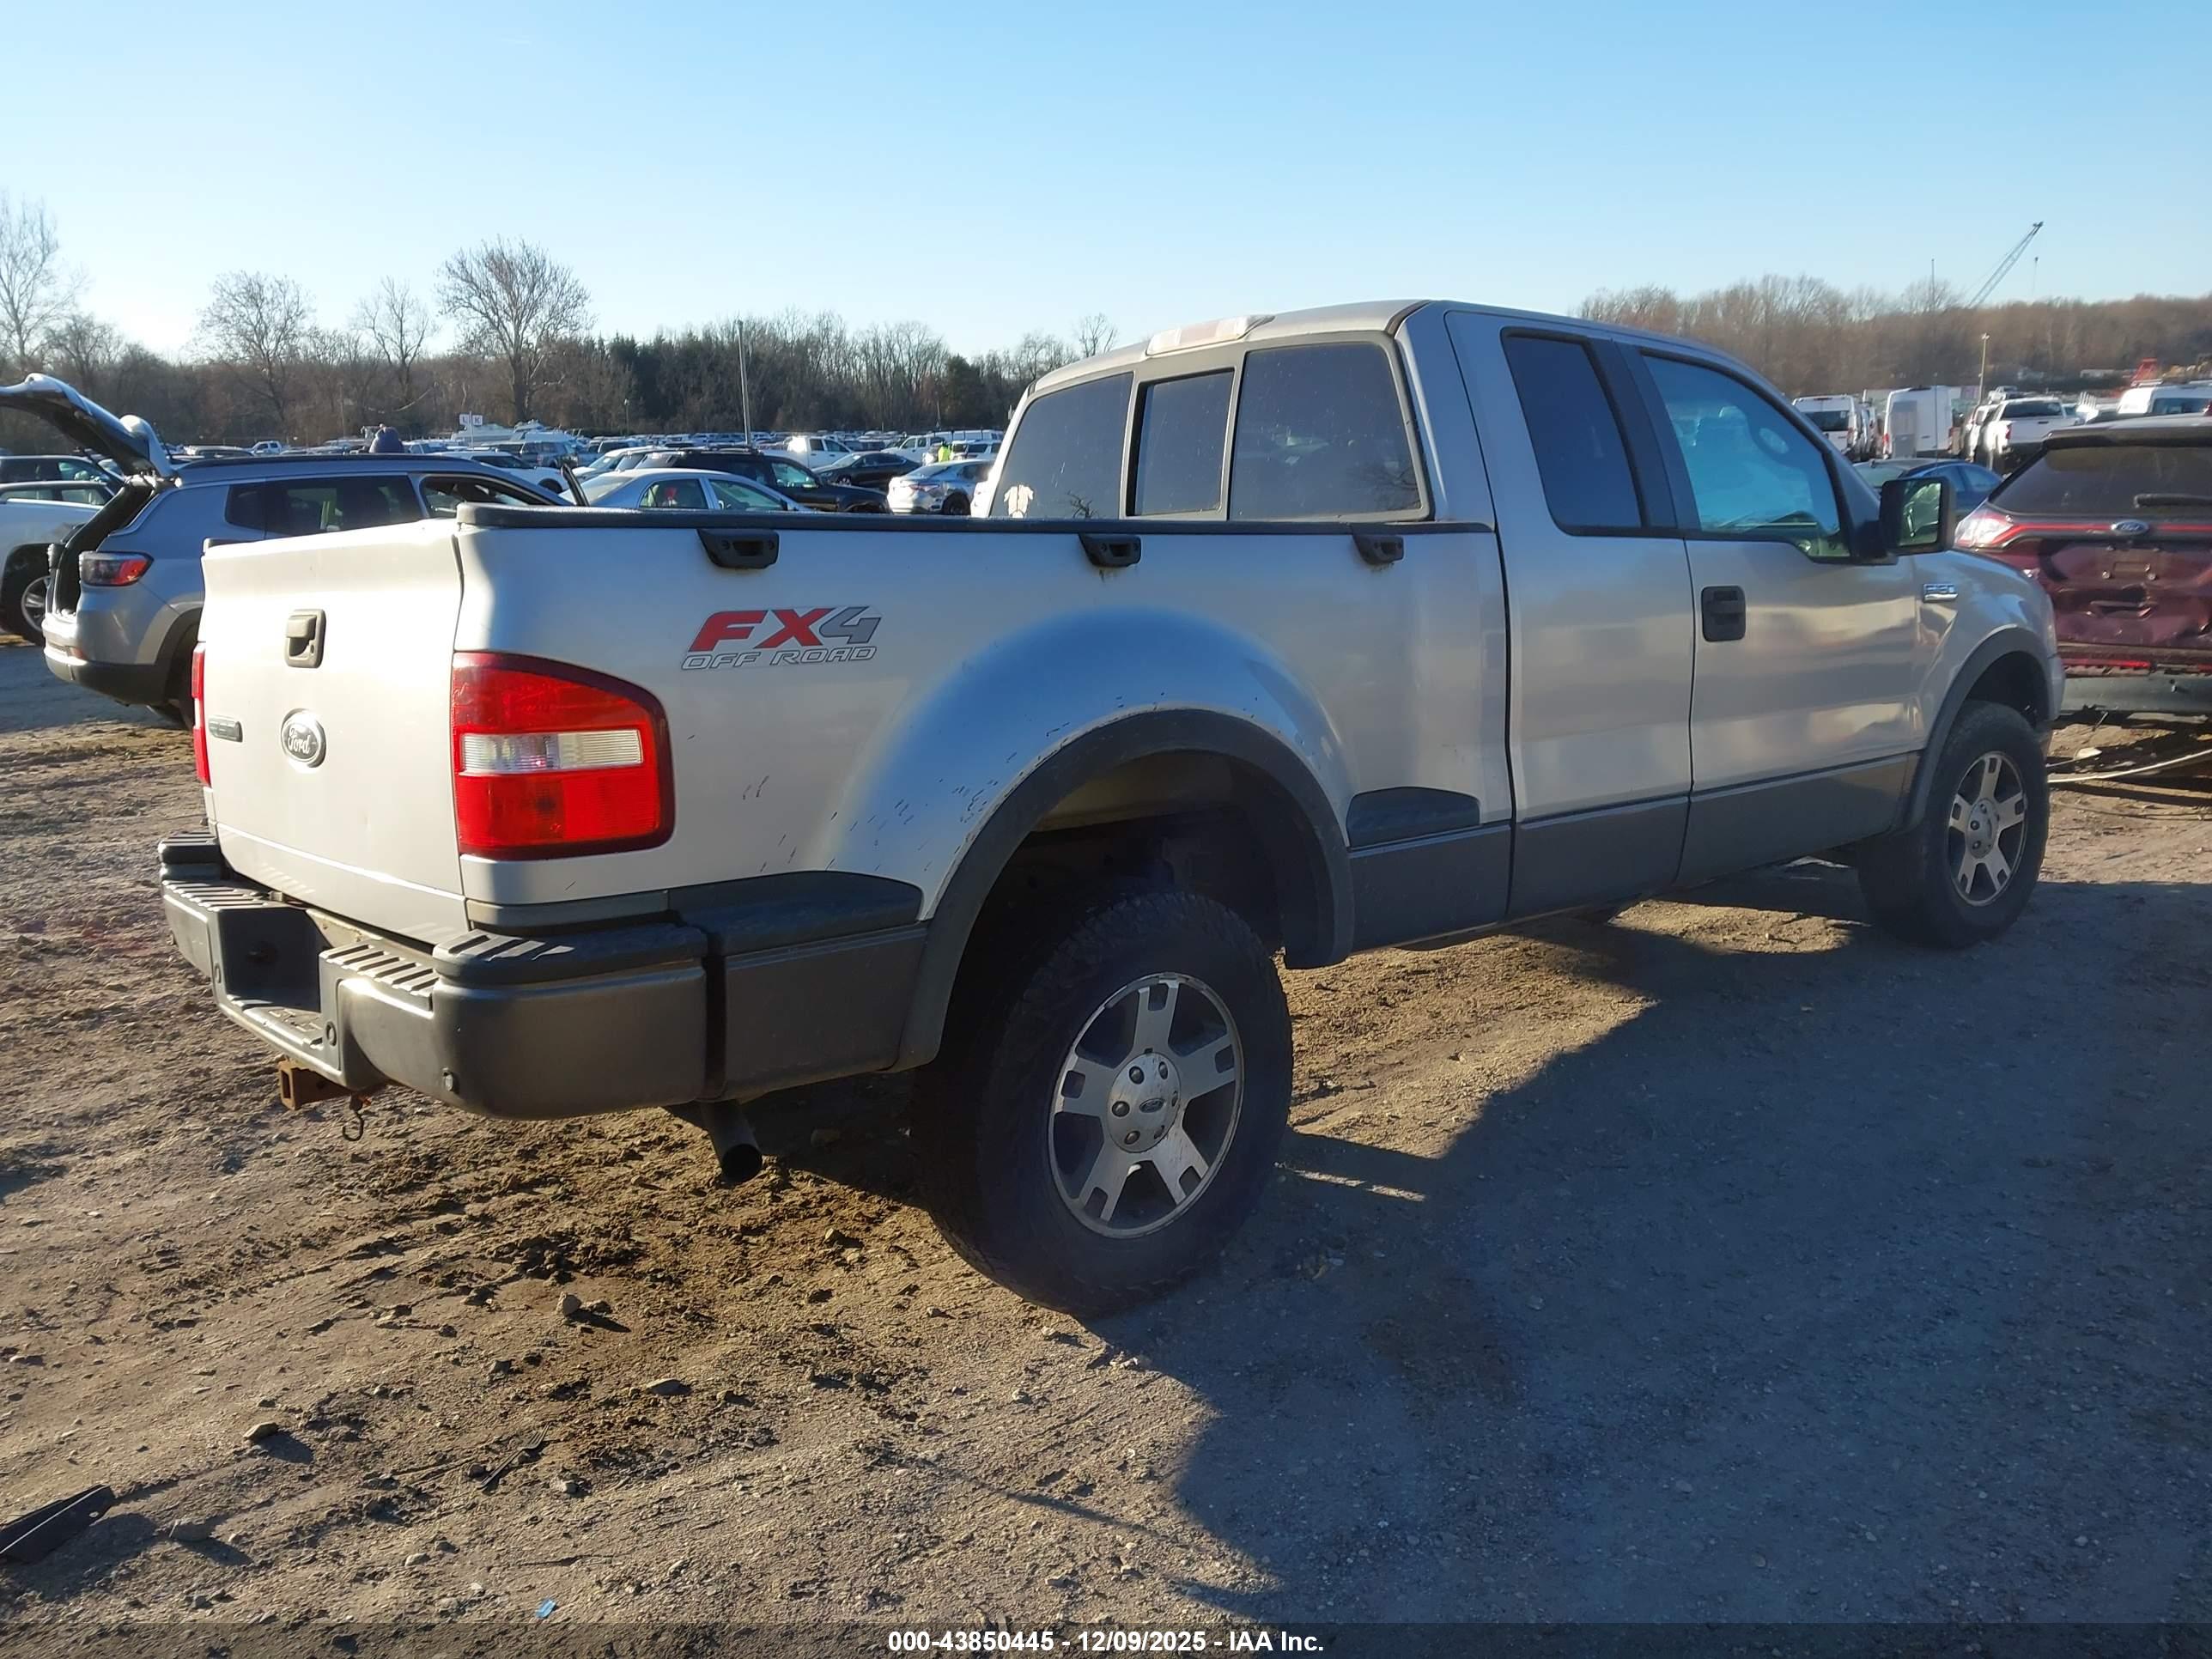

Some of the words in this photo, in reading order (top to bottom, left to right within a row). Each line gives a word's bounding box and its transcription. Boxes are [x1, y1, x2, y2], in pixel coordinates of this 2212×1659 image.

[688, 605, 882, 653] FX4
[681, 651, 761, 671] OFF
[769, 646, 878, 665] ROAD
[287, 726, 311, 755] Ford
